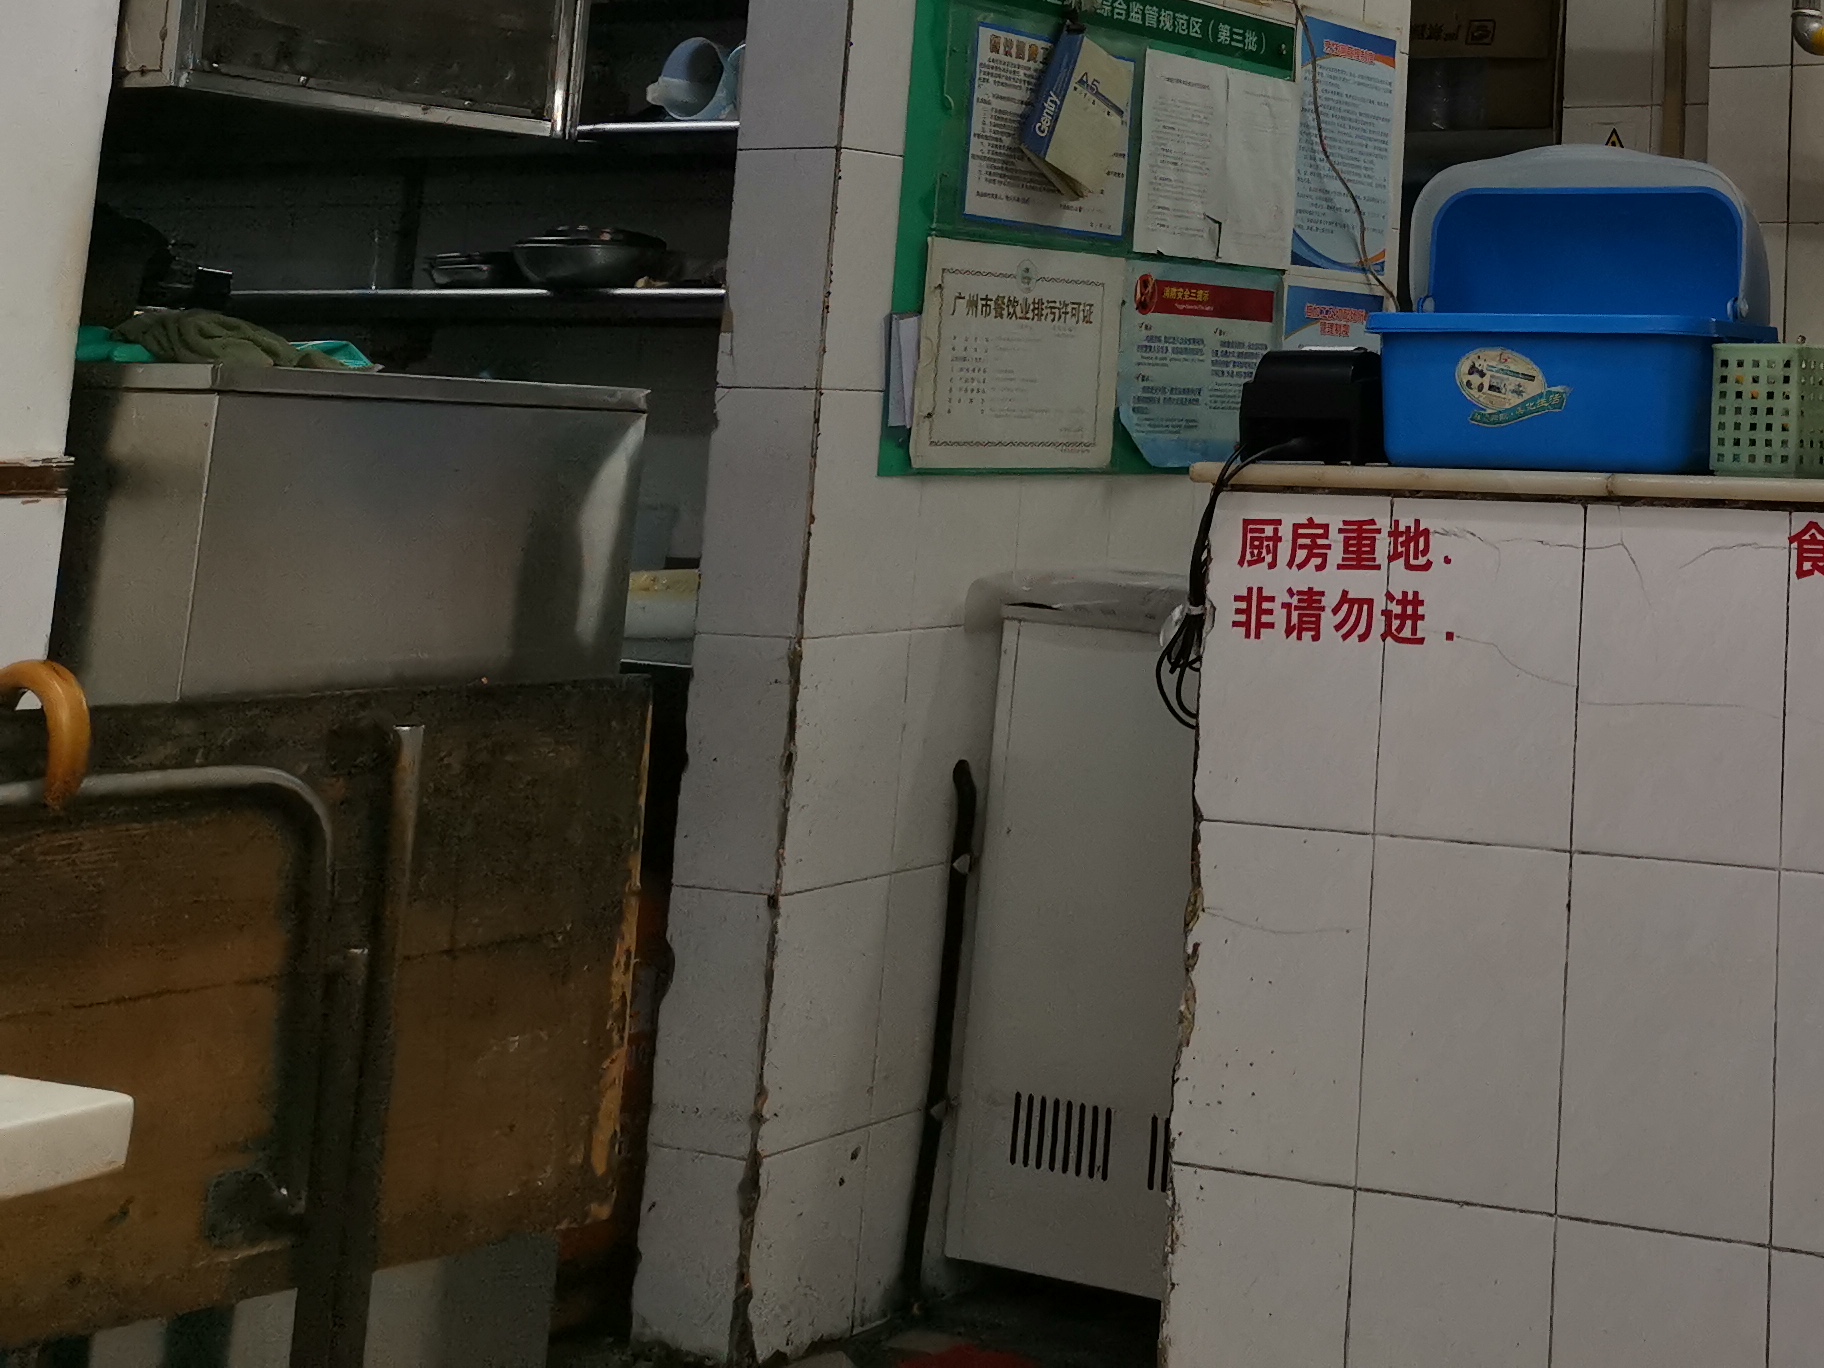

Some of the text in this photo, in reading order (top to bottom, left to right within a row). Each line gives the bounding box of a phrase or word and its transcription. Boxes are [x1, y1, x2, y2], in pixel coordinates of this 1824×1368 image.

[1075, 70, 1101, 94] A5
[1035, 90, 1060, 138] Gentry
[951, 290, 1095, 325] 广州市餐饮业排污许可证
